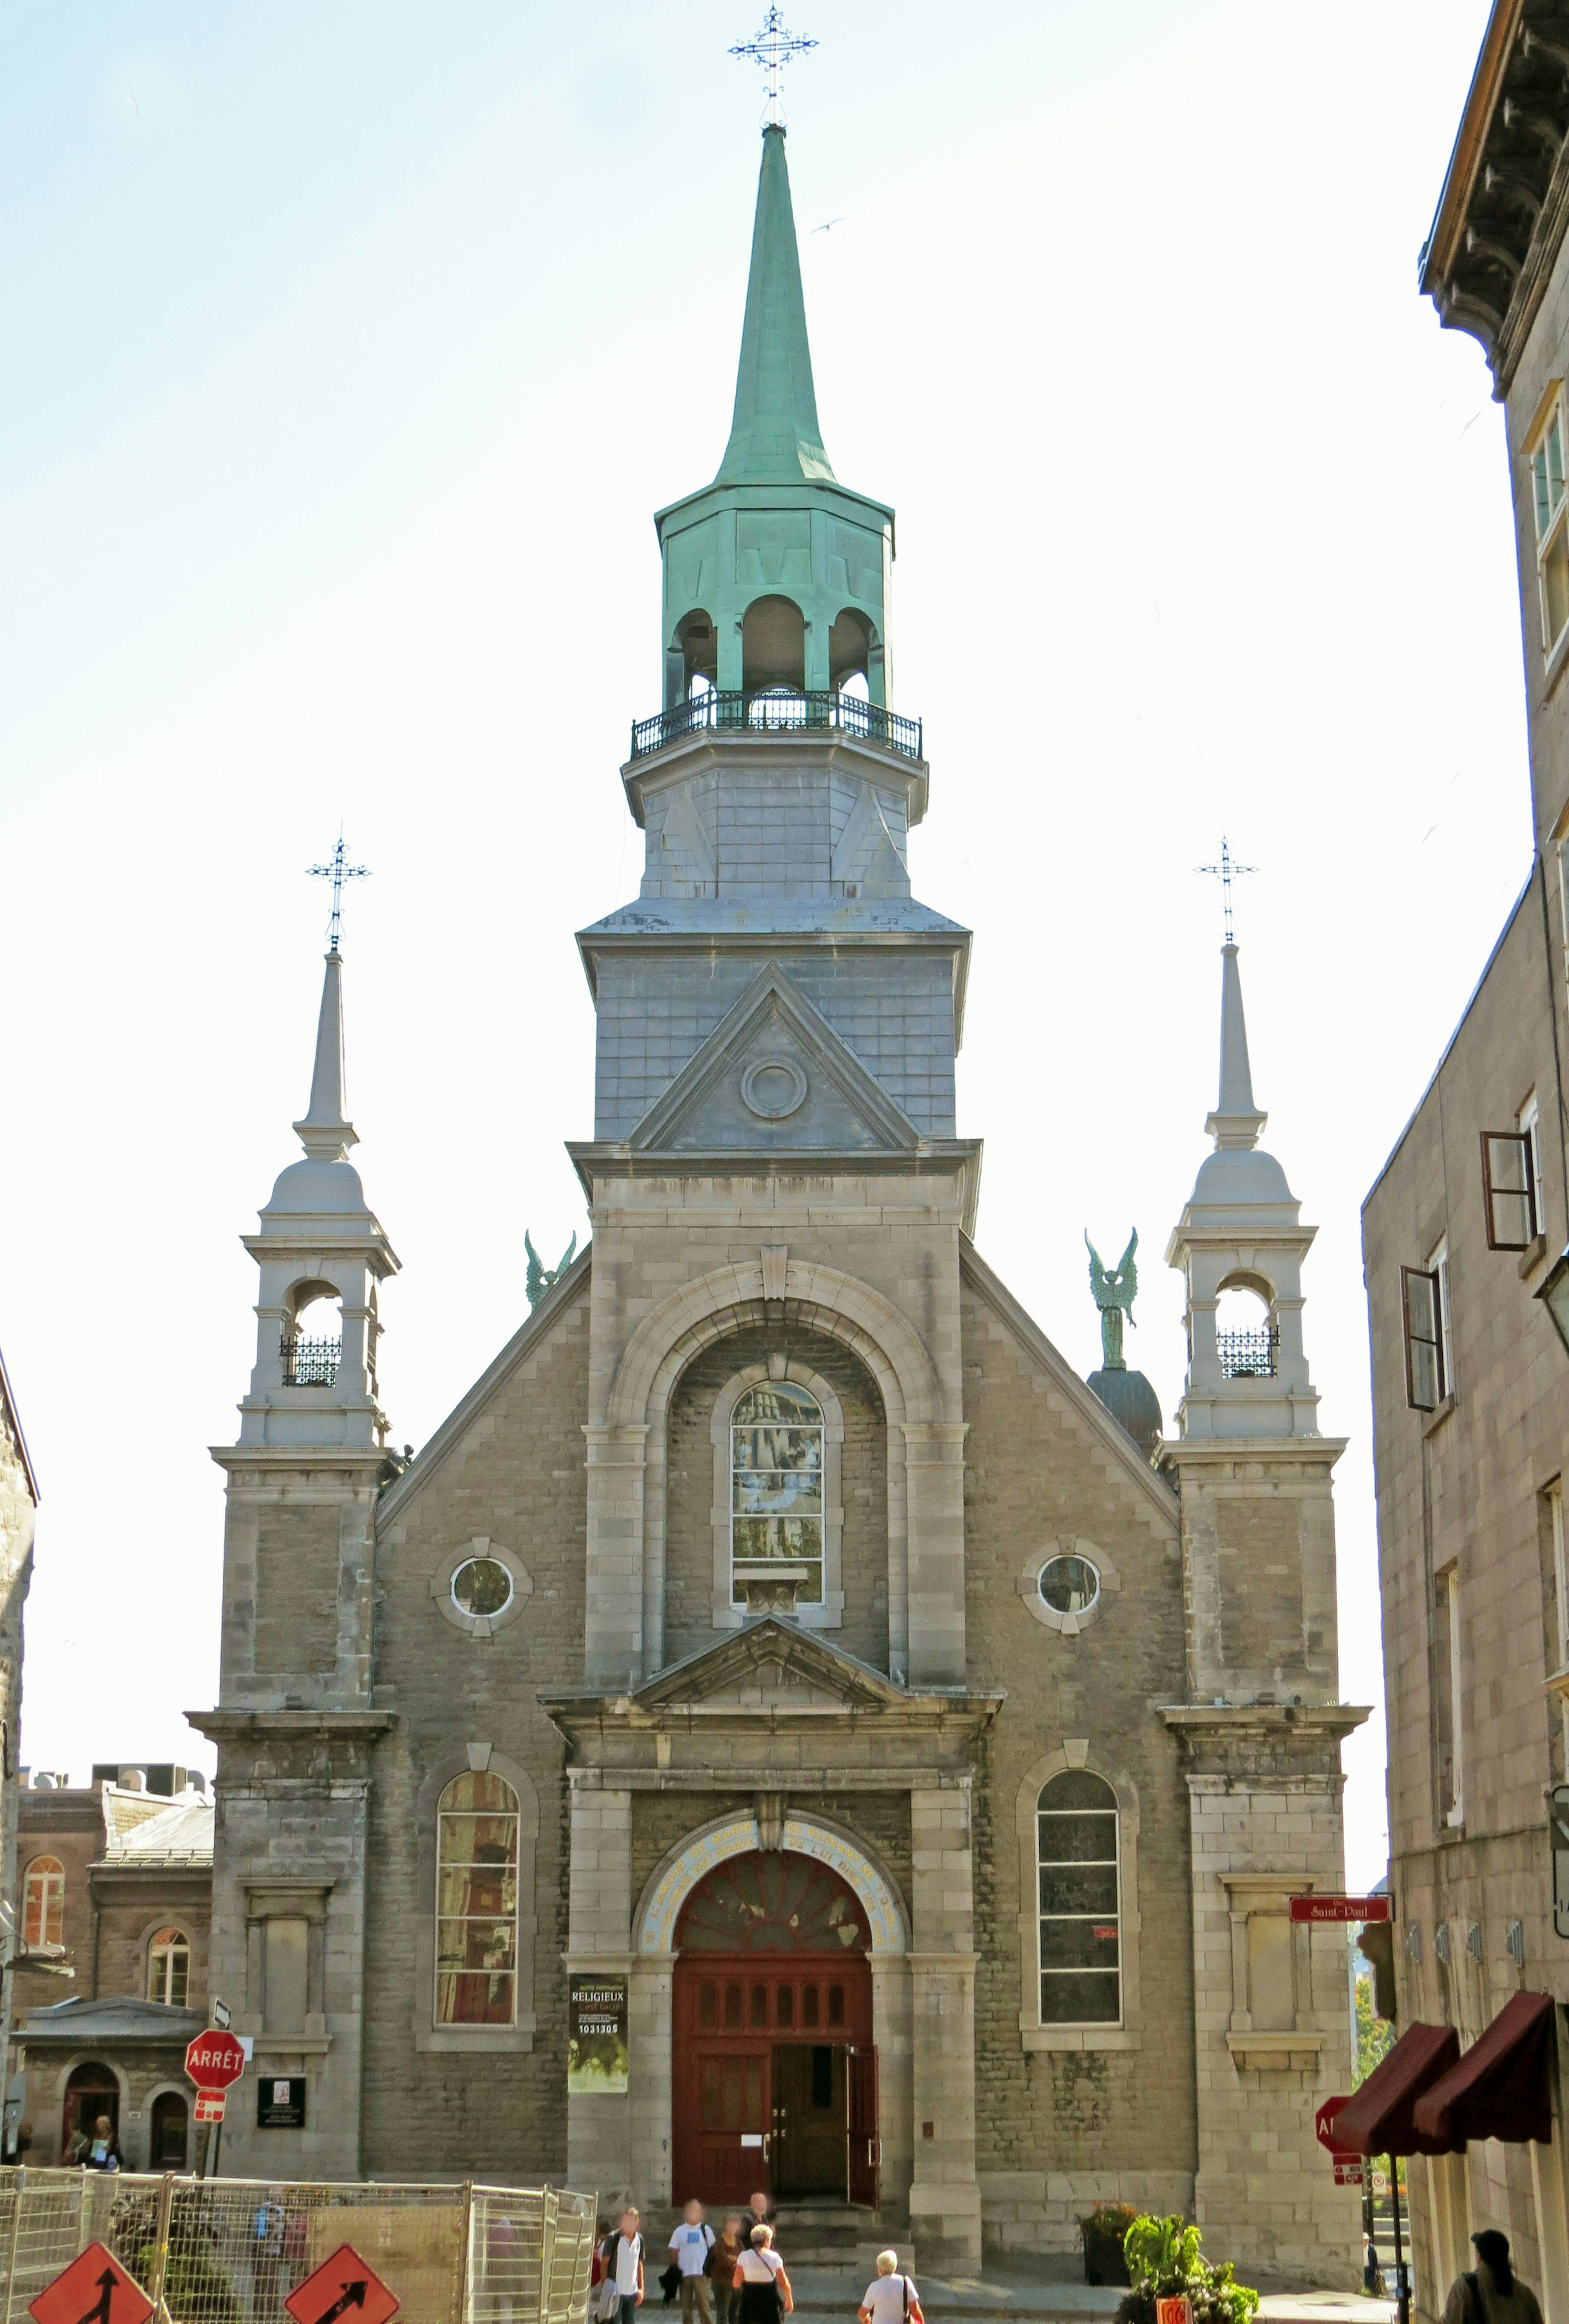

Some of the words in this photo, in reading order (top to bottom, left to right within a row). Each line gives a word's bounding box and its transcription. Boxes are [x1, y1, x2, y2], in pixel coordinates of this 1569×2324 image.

[711, 1822, 751, 1844] MARIE
[786, 1823, 801, 1833] EN
[861, 1863, 874, 1880] NE
[572, 1992, 624, 2002] RELIGIEUX
[189, 2049, 242, 2070] ARRÊT
